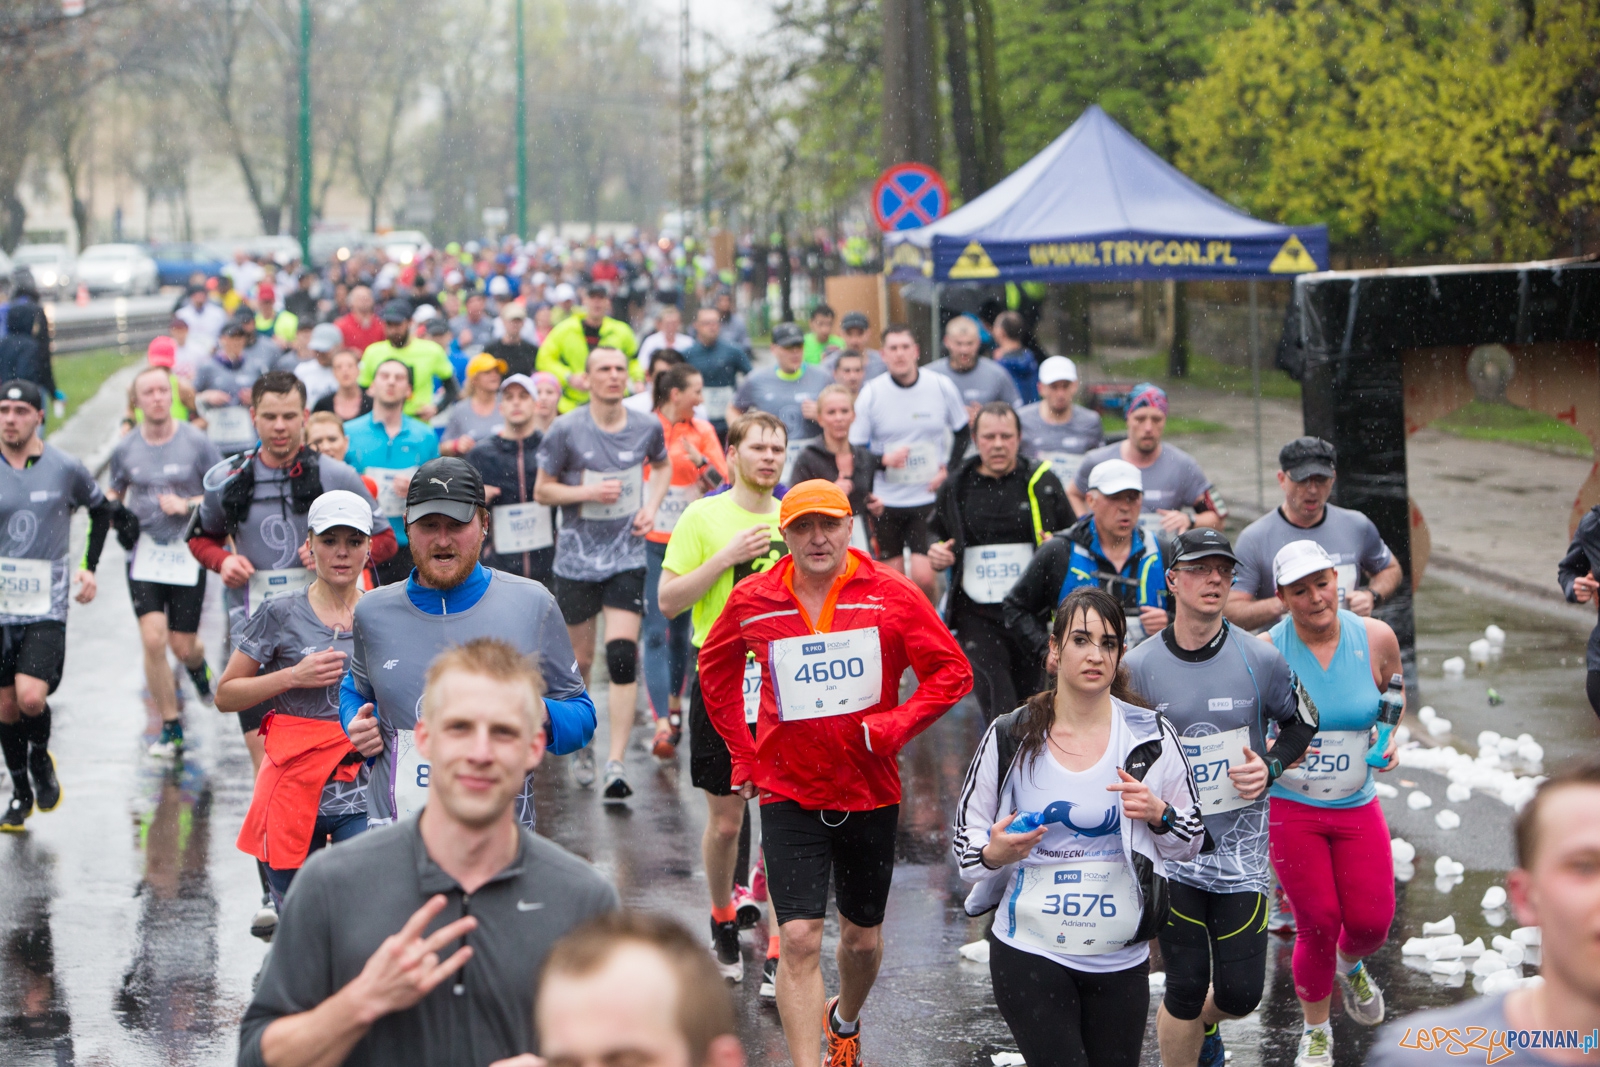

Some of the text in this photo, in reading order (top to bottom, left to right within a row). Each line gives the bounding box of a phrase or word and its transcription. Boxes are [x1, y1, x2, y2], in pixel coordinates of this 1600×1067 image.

[1030, 240, 1238, 267] WWW.TRYGON.PL
[260, 513, 298, 570] 9
[975, 562, 1020, 579] 9639
[383, 660, 399, 670] 4F
[794, 657, 865, 684] 4600
[1193, 759, 1230, 784] 871
[1299, 754, 1350, 772] 250
[1036, 847, 1085, 859] WRONIECKI
[1041, 893, 1117, 918] 3676
[1061, 919, 1097, 928] Adrianna
